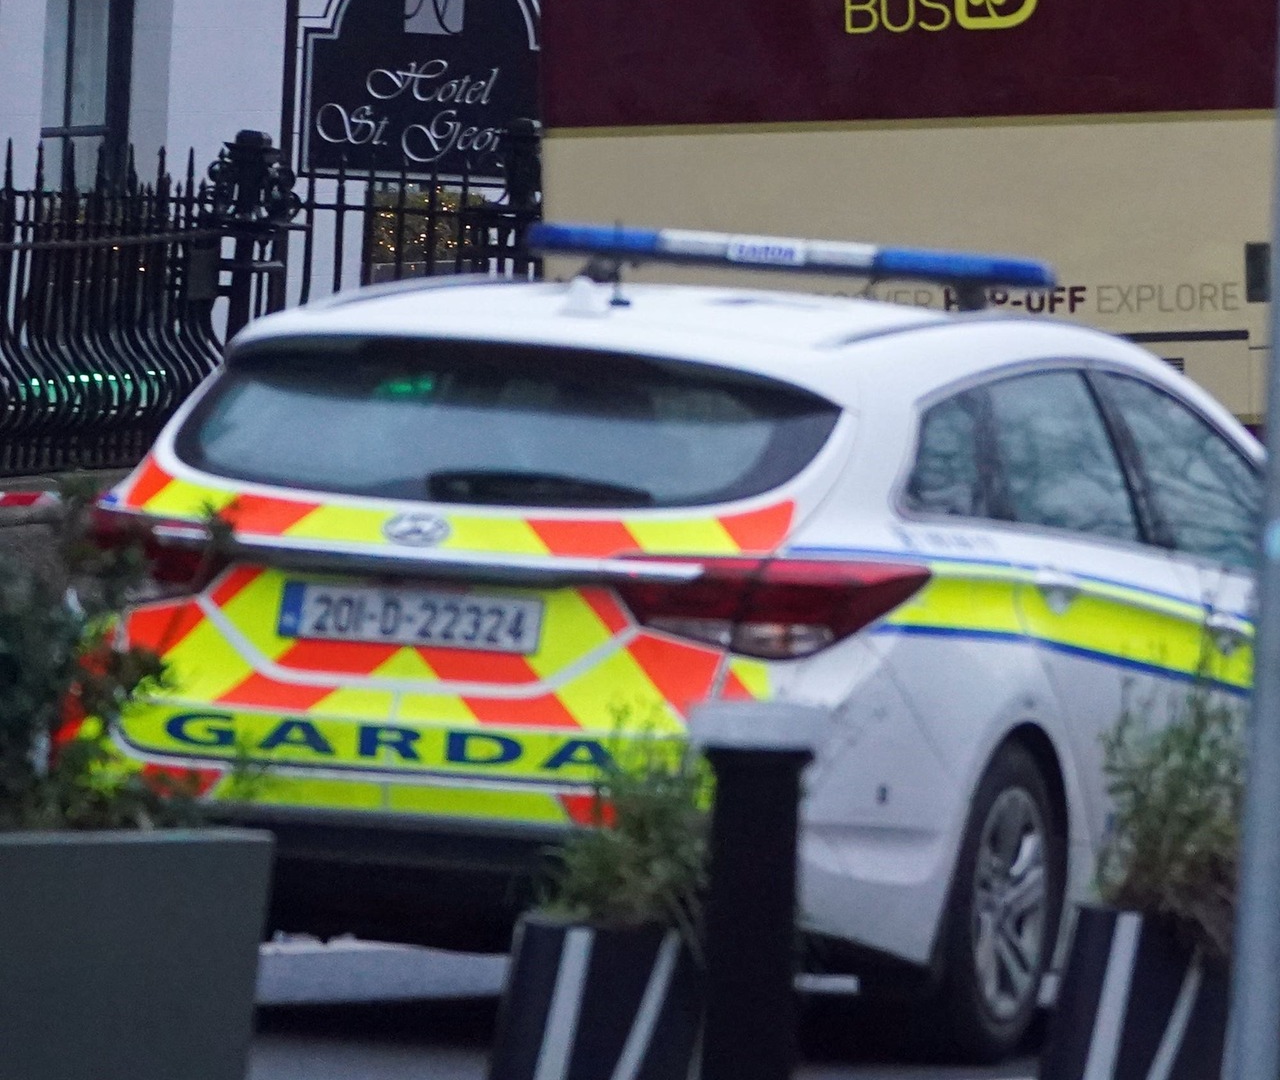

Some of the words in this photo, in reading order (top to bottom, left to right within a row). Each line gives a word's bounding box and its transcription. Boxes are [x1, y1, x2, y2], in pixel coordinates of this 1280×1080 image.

[366, 59, 499, 104] Hotel
[402, 110, 508, 162] Geor
[1097, 282, 1239, 313] EXPLORE
[311, 592, 526, 645] 201-D-22324
[165, 713, 621, 771] GARDA
